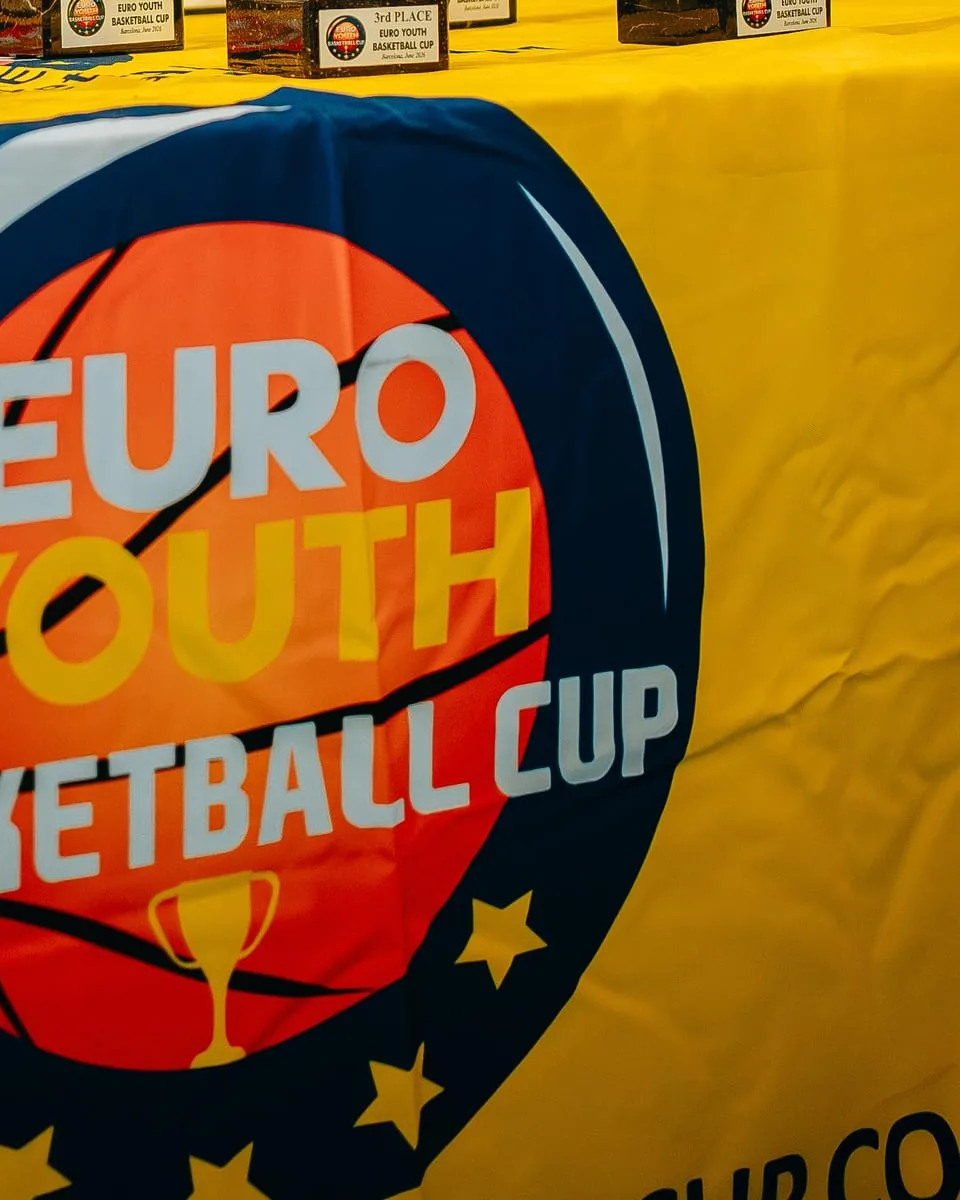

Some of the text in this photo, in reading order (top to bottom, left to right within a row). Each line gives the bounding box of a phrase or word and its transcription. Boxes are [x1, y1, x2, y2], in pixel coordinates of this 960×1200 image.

[118, 1, 163, 13] EURO YOUTH
[777, 8, 811, 18] BASKETBALL
[811, 7, 823, 15] CUP
[111, 14, 169, 26] BASKETBALL CUP
[374, 10, 432, 23] 3rd PLACE
[379, 28, 427, 38] EURO YOUTH
[372, 40, 434, 51] BASKETBALL CUP
[493, 664, 679, 798] CUP
